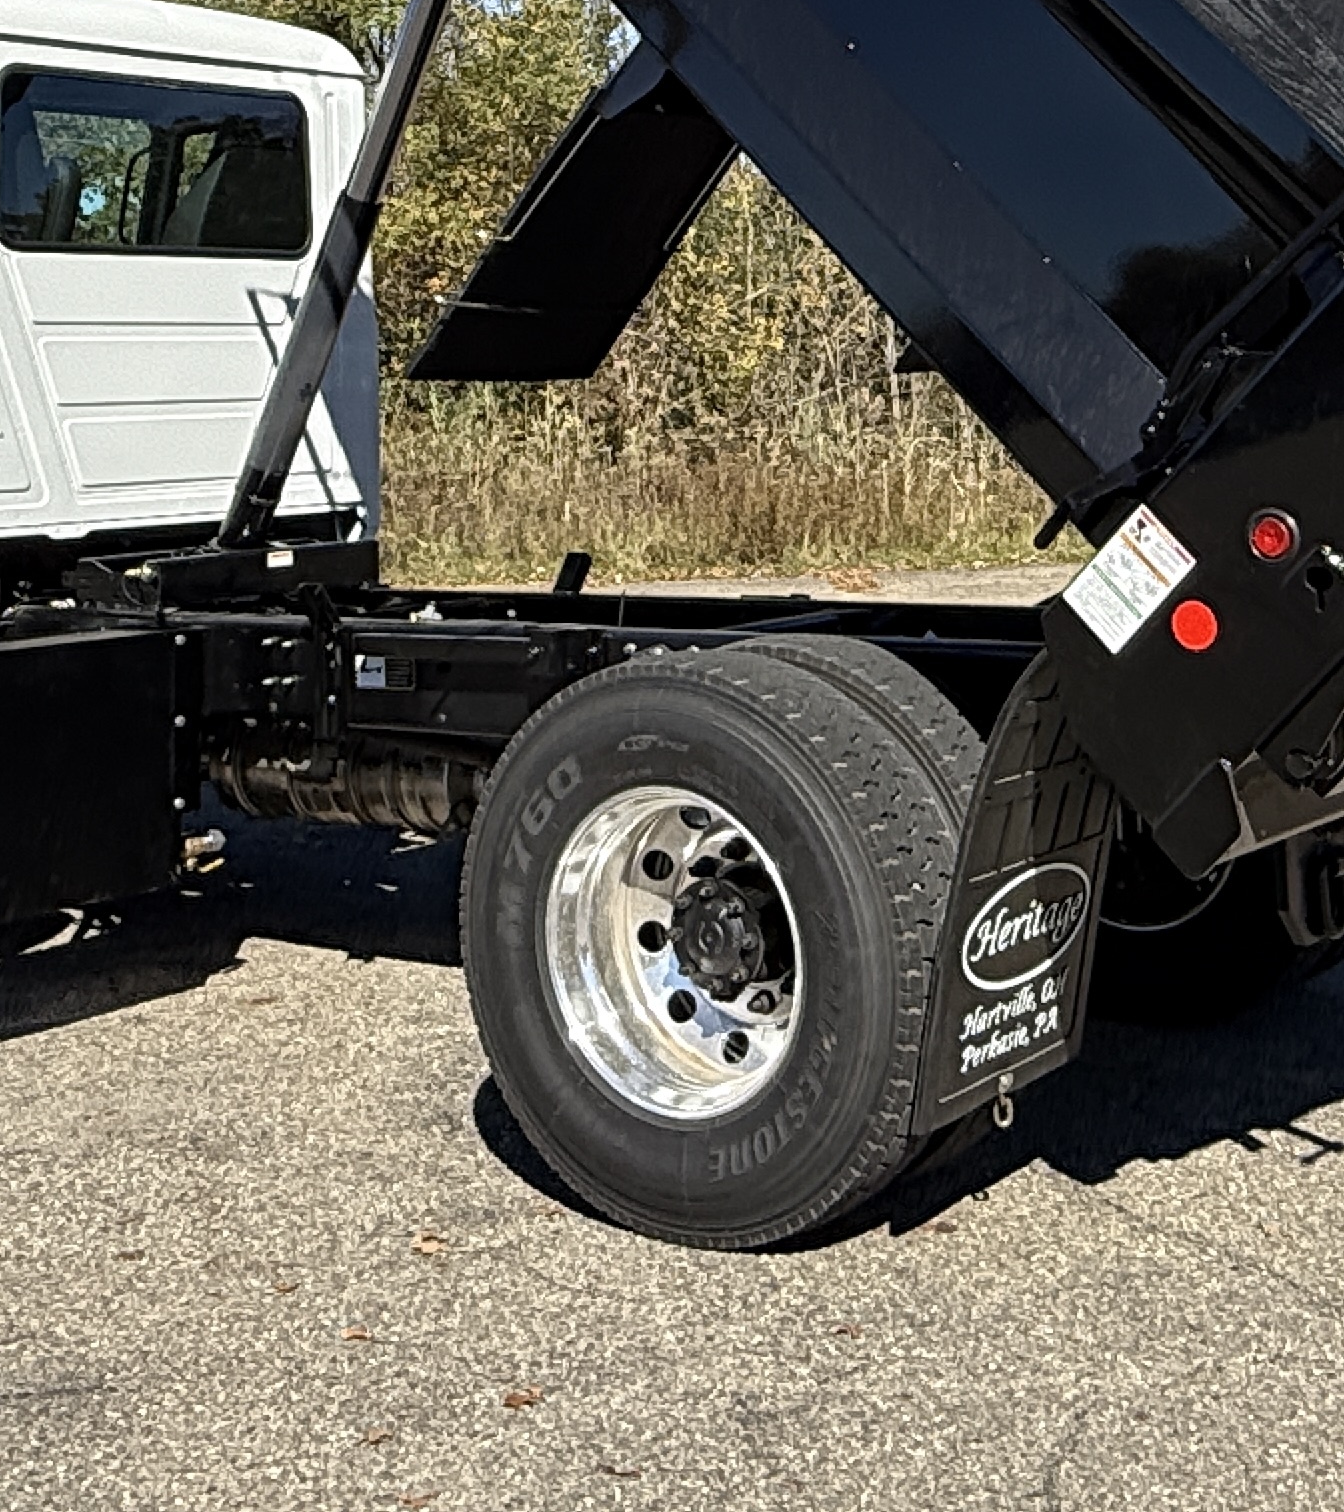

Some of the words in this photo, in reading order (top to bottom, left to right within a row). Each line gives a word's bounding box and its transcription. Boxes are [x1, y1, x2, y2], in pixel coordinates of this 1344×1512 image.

[969, 891, 1084, 963] Heritage
[958, 982, 1037, 1042] Hartville,
[1033, 1005, 1059, 1039] PA
